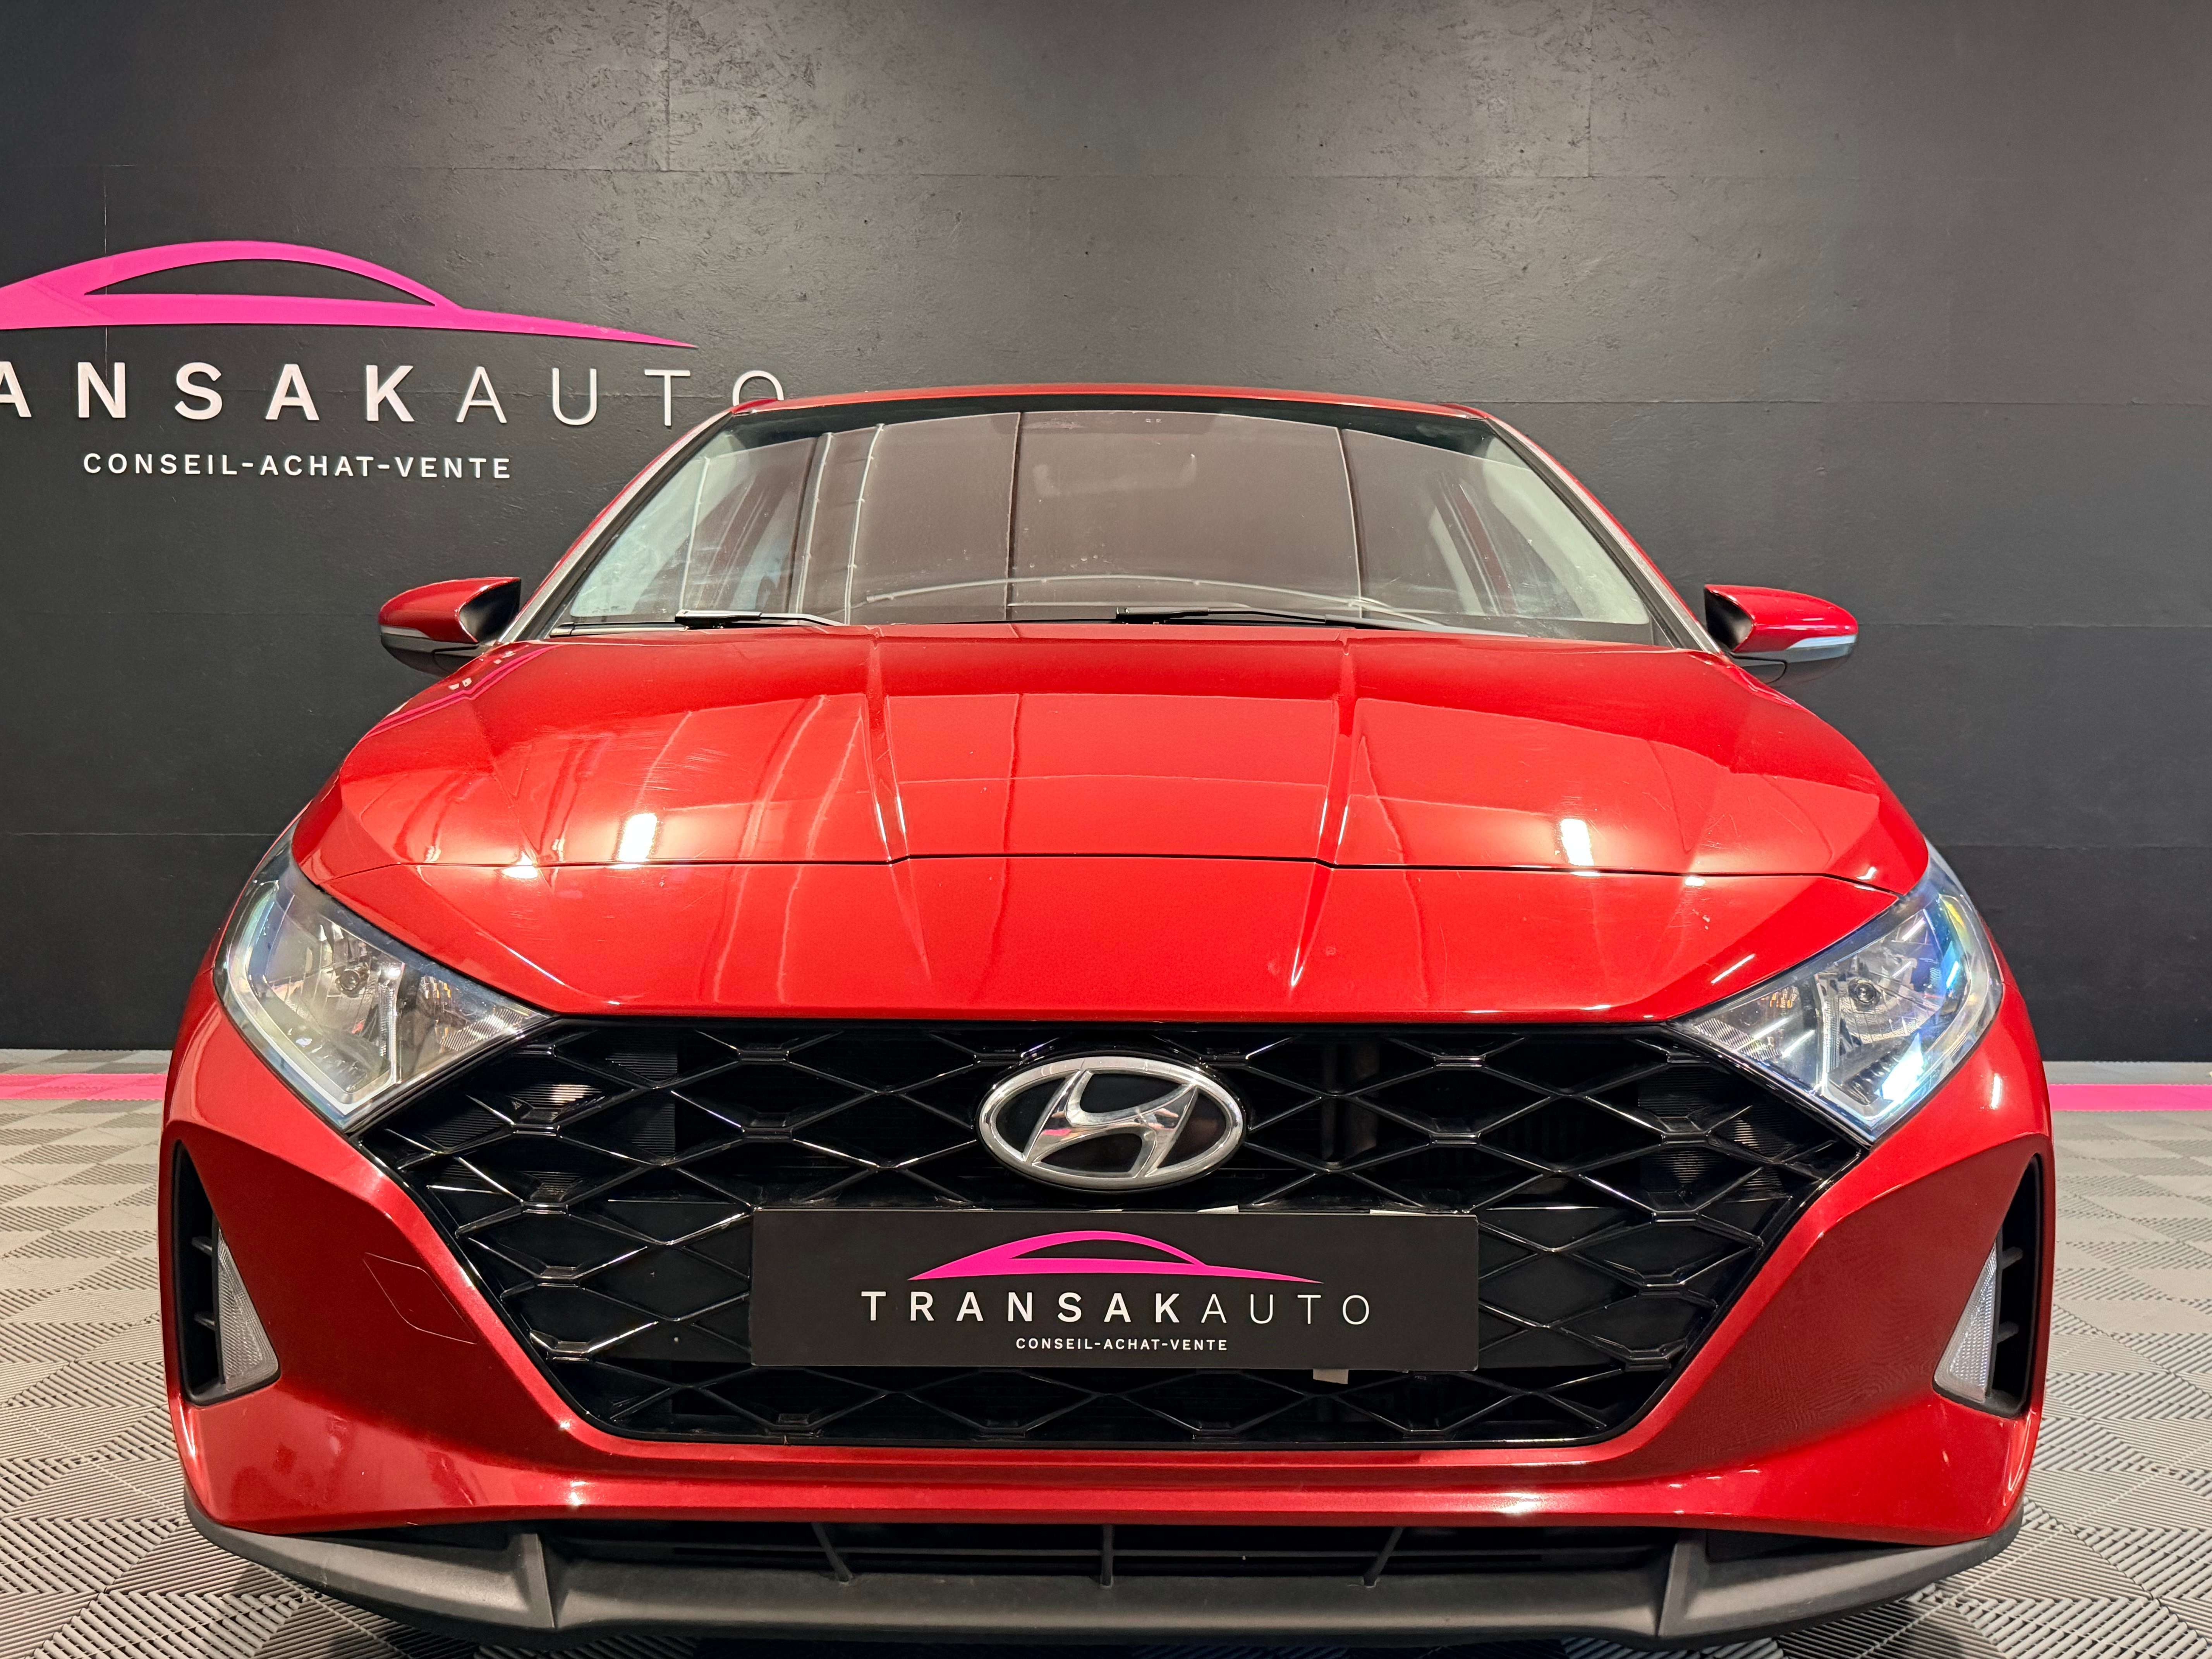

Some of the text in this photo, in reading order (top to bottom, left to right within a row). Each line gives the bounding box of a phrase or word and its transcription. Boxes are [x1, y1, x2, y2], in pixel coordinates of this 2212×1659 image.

[83, 453, 510, 479] CONSEIL-ACHAT-VENTE
[861, 1291, 1370, 1325] TRANSAKAUTO
[1016, 1338, 1228, 1351] CONSEIL-ACHAT-VENTE
